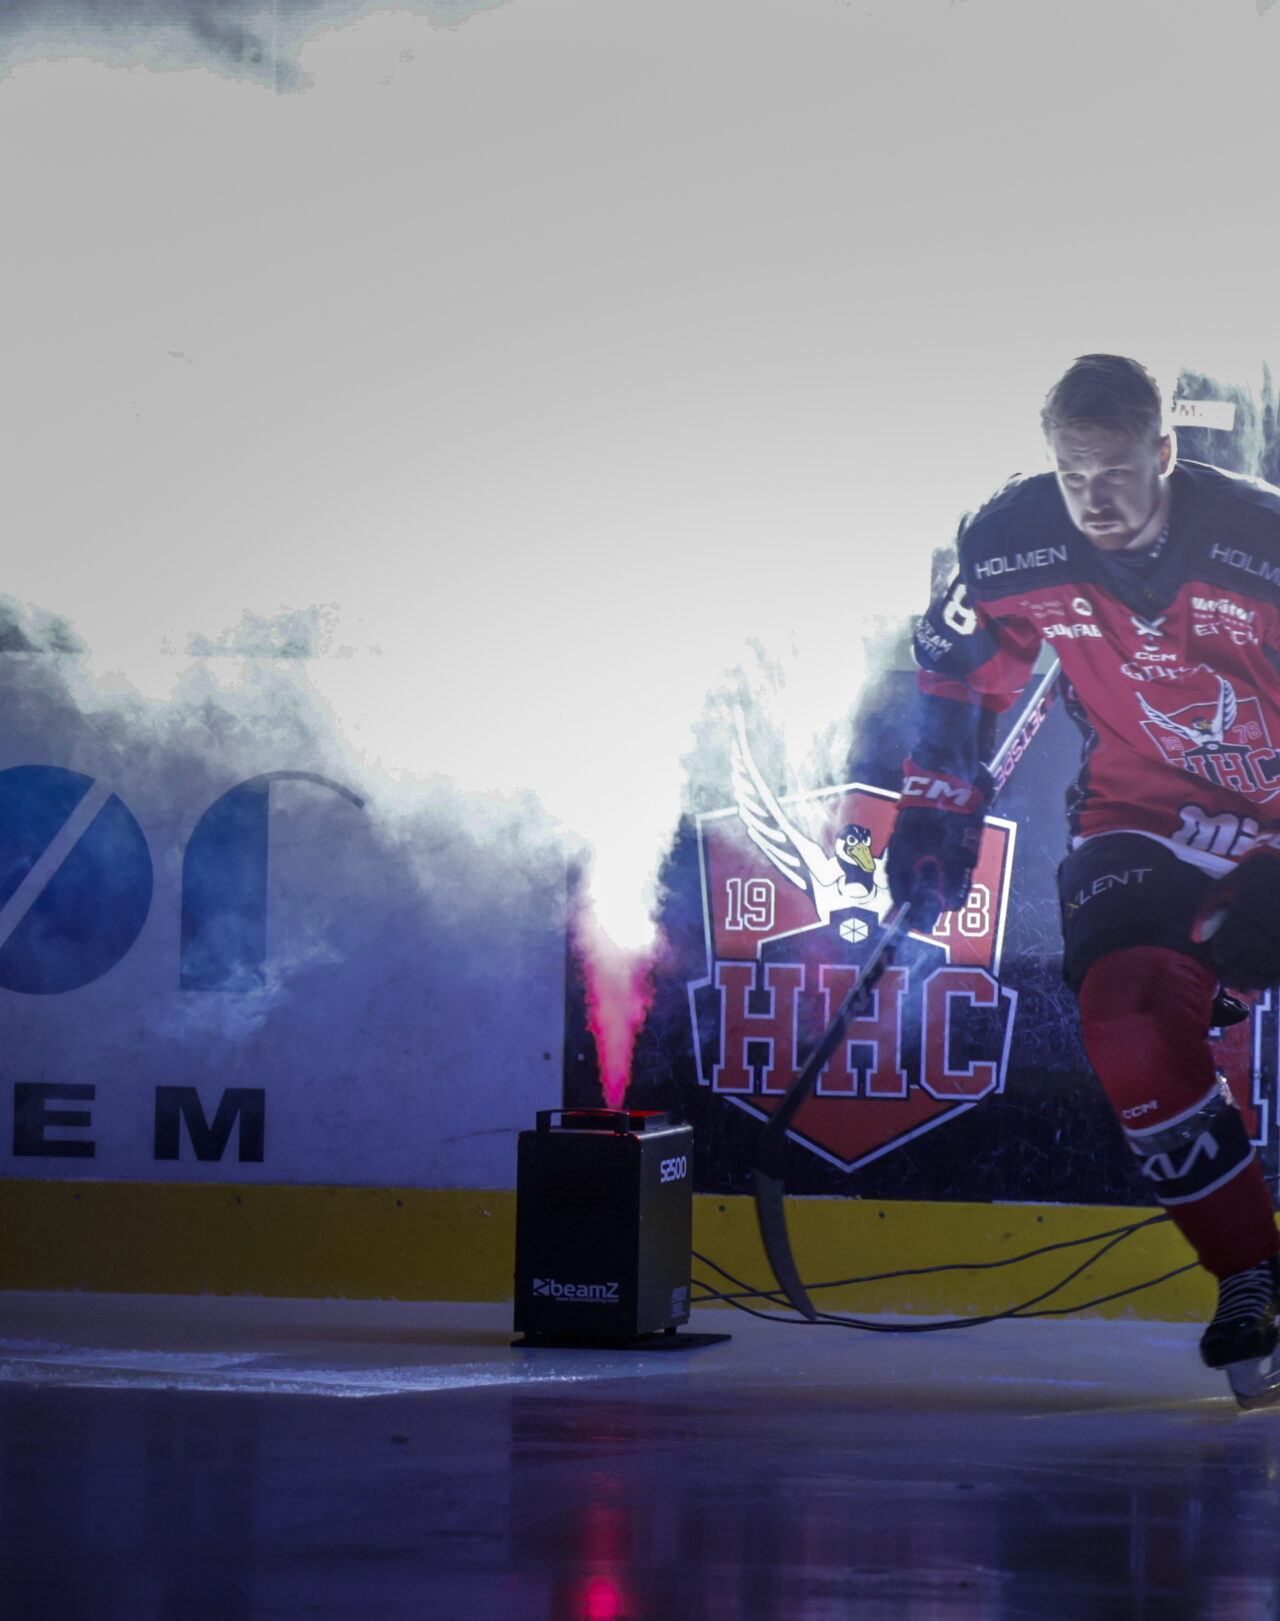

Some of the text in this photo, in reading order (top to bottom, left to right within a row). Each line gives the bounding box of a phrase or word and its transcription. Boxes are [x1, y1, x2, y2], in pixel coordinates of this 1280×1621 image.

[974, 544, 1068, 580] HOLMEN
[1134, 651, 1178, 662] CCM
[1232, 721, 1263, 744] 78
[725, 877, 776, 932] 19
[712, 960, 1000, 1100] HHC
[1122, 1100, 1158, 1119] CCM
